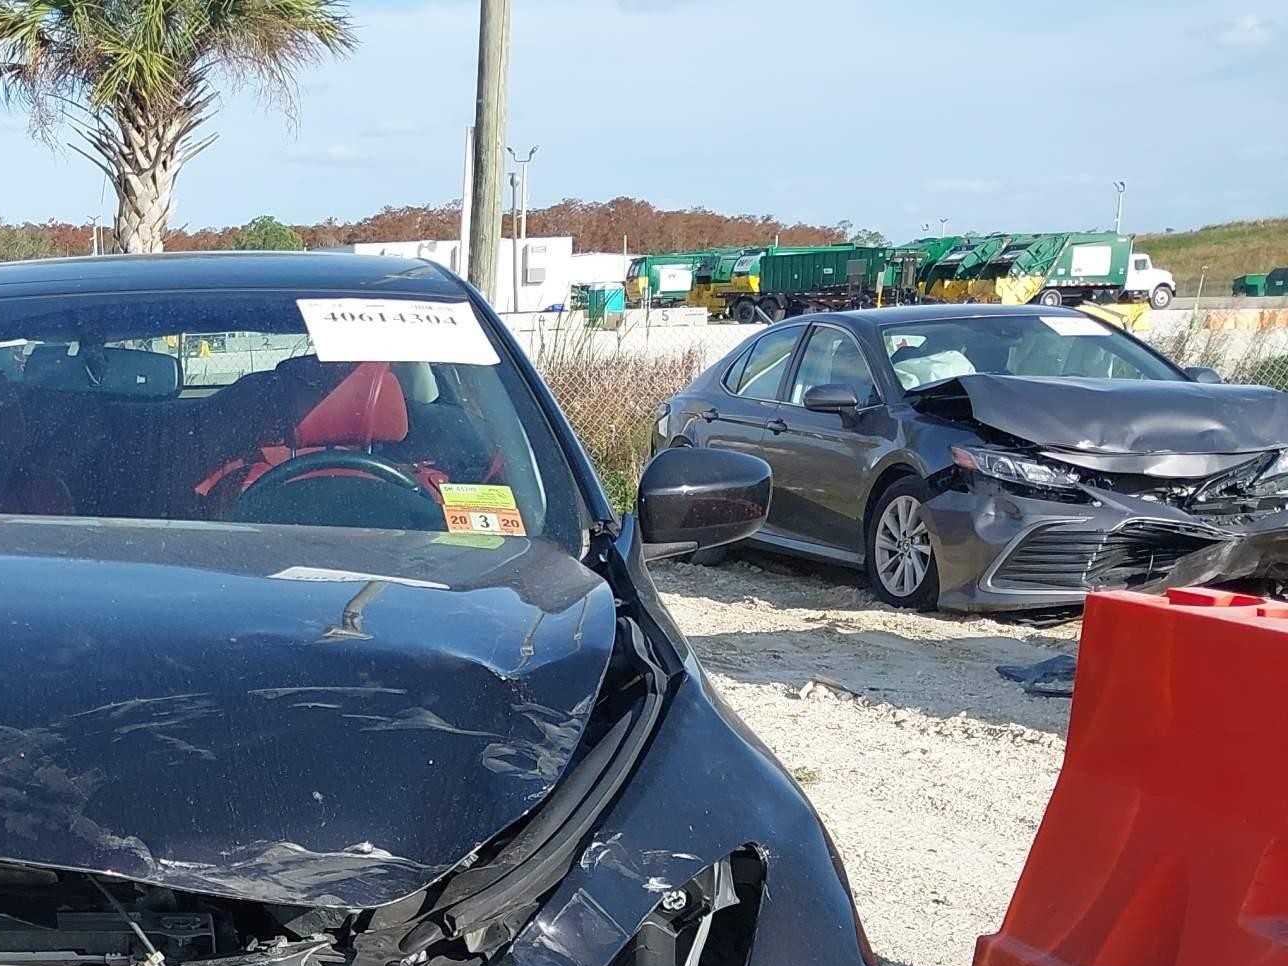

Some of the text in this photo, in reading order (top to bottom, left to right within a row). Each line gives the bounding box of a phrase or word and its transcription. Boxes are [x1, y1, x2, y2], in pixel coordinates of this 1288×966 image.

[323, 311, 458, 326] 40614304
[450, 514, 520, 528] 20 3 20
